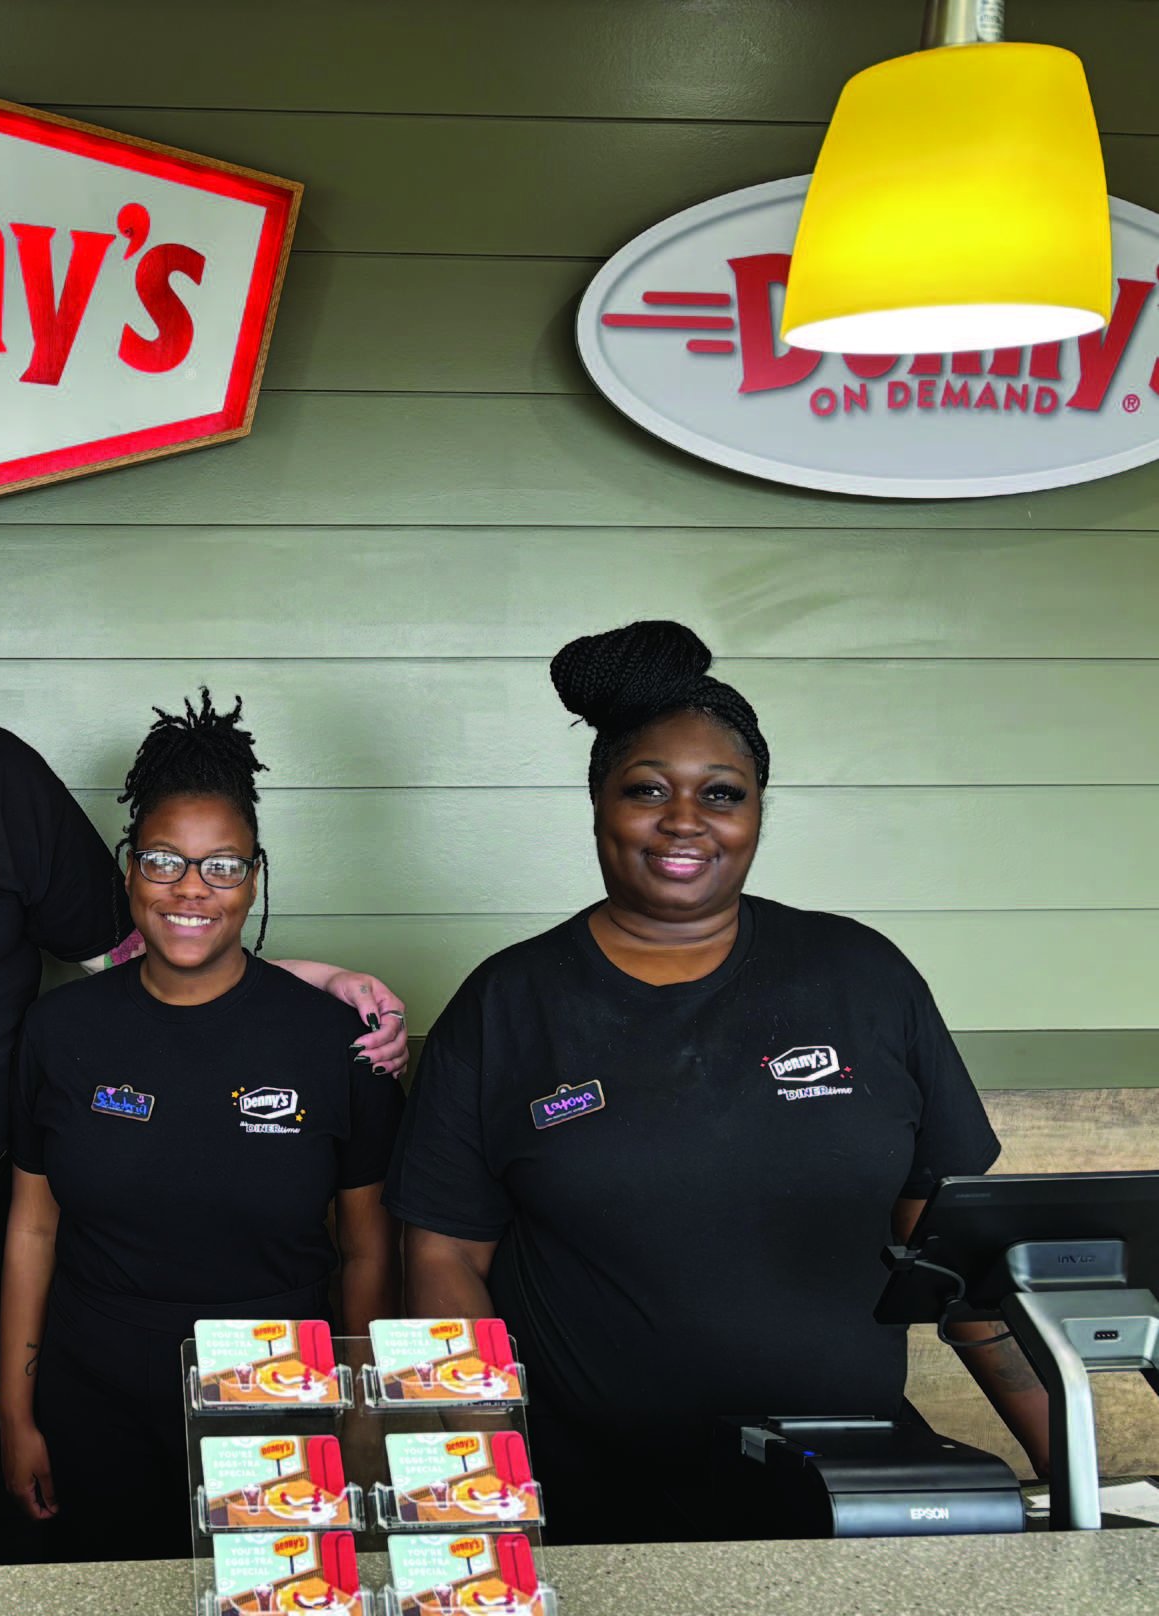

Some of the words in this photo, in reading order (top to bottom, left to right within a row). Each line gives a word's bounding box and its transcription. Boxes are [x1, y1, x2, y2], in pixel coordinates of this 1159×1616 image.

[809, 383, 868, 417] ON
[887, 379, 1059, 414] DEMAND
[773, 1050, 829, 1076] Denny's
[243, 1092, 289, 1111] Denny's
[261, 1441, 291, 1456] Denny's
[910, 1507, 949, 1520] EPSON
[274, 1537, 305, 1553] Denny's
[450, 1538, 480, 1553] Denny's
